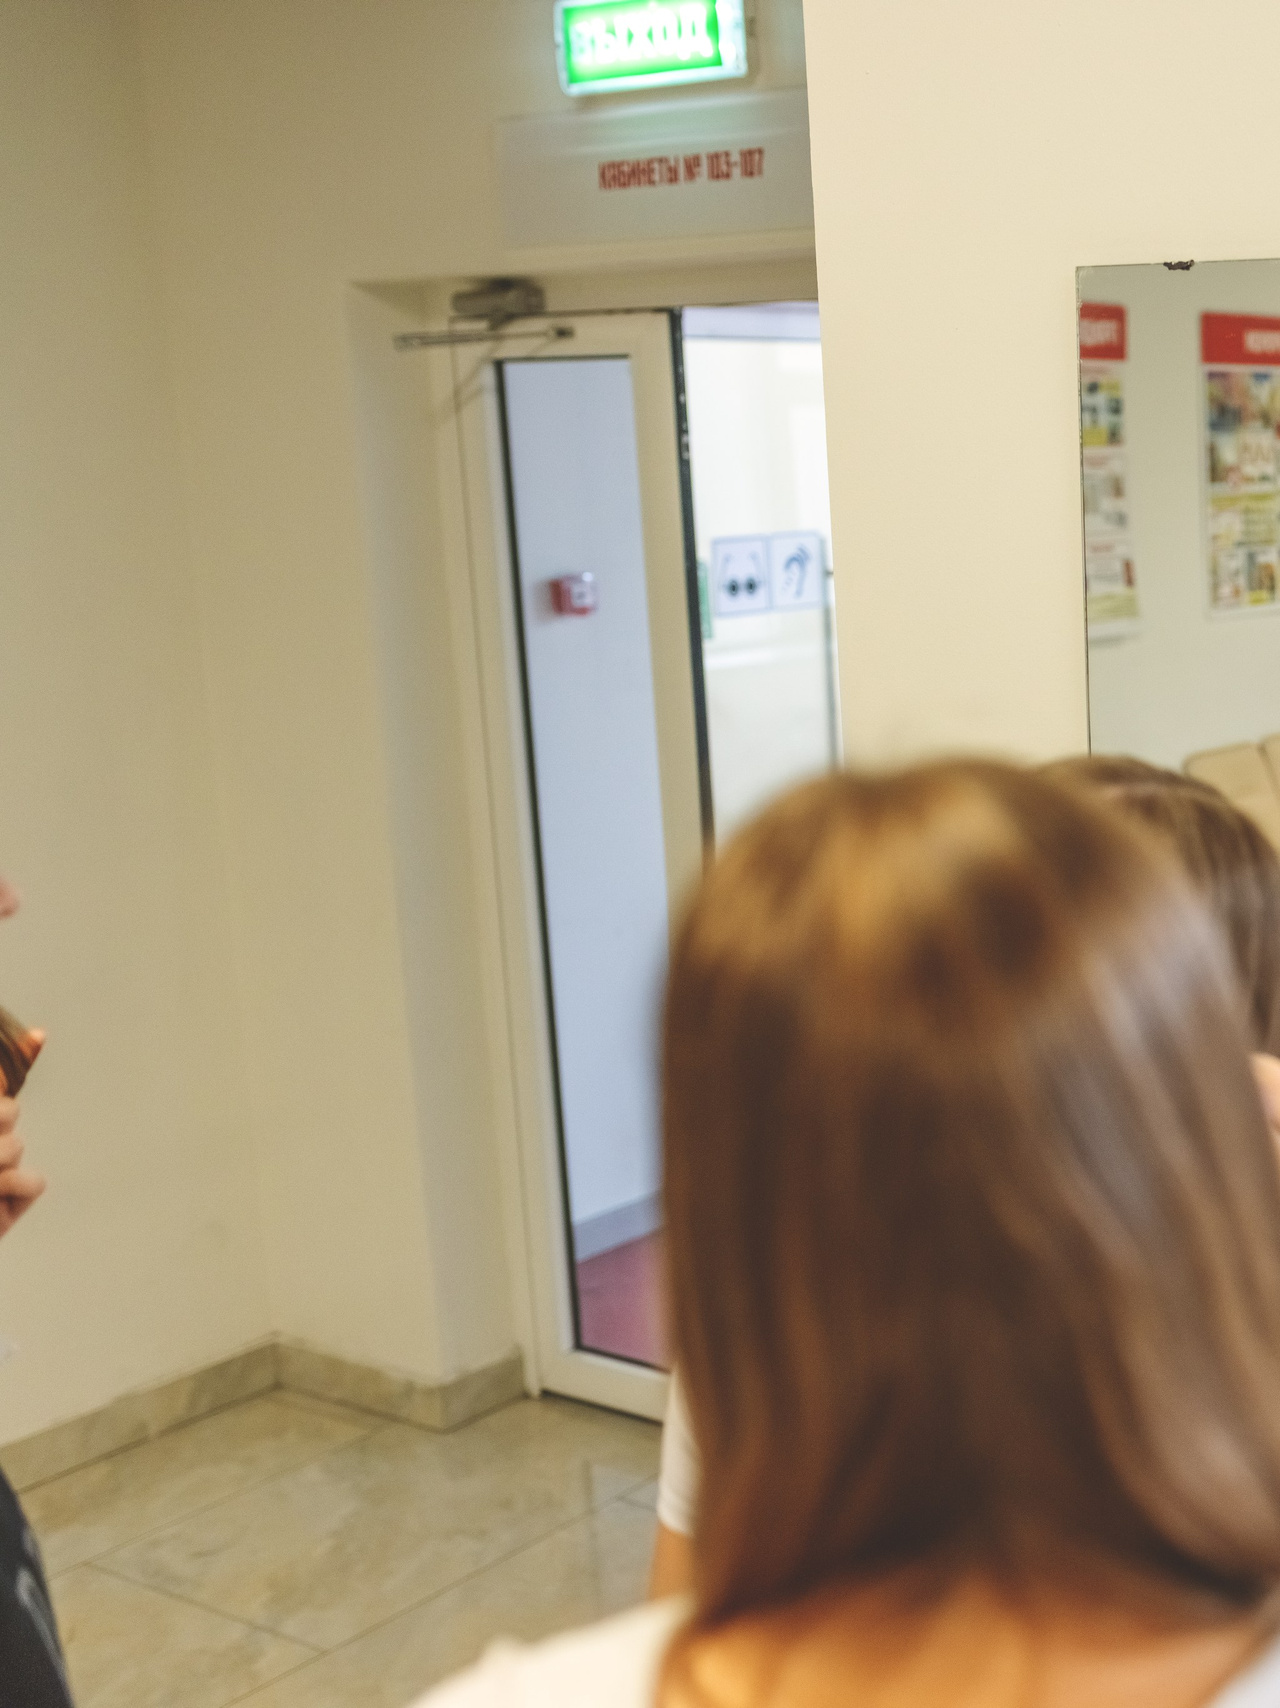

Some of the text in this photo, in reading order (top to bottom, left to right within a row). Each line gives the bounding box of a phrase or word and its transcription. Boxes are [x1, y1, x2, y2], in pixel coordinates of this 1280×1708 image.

[572, 3, 714, 64] ВЫХОД
[598, 155, 680, 190] КАБИНЕТЫ
[707, 147, 764, 181] 103-107
